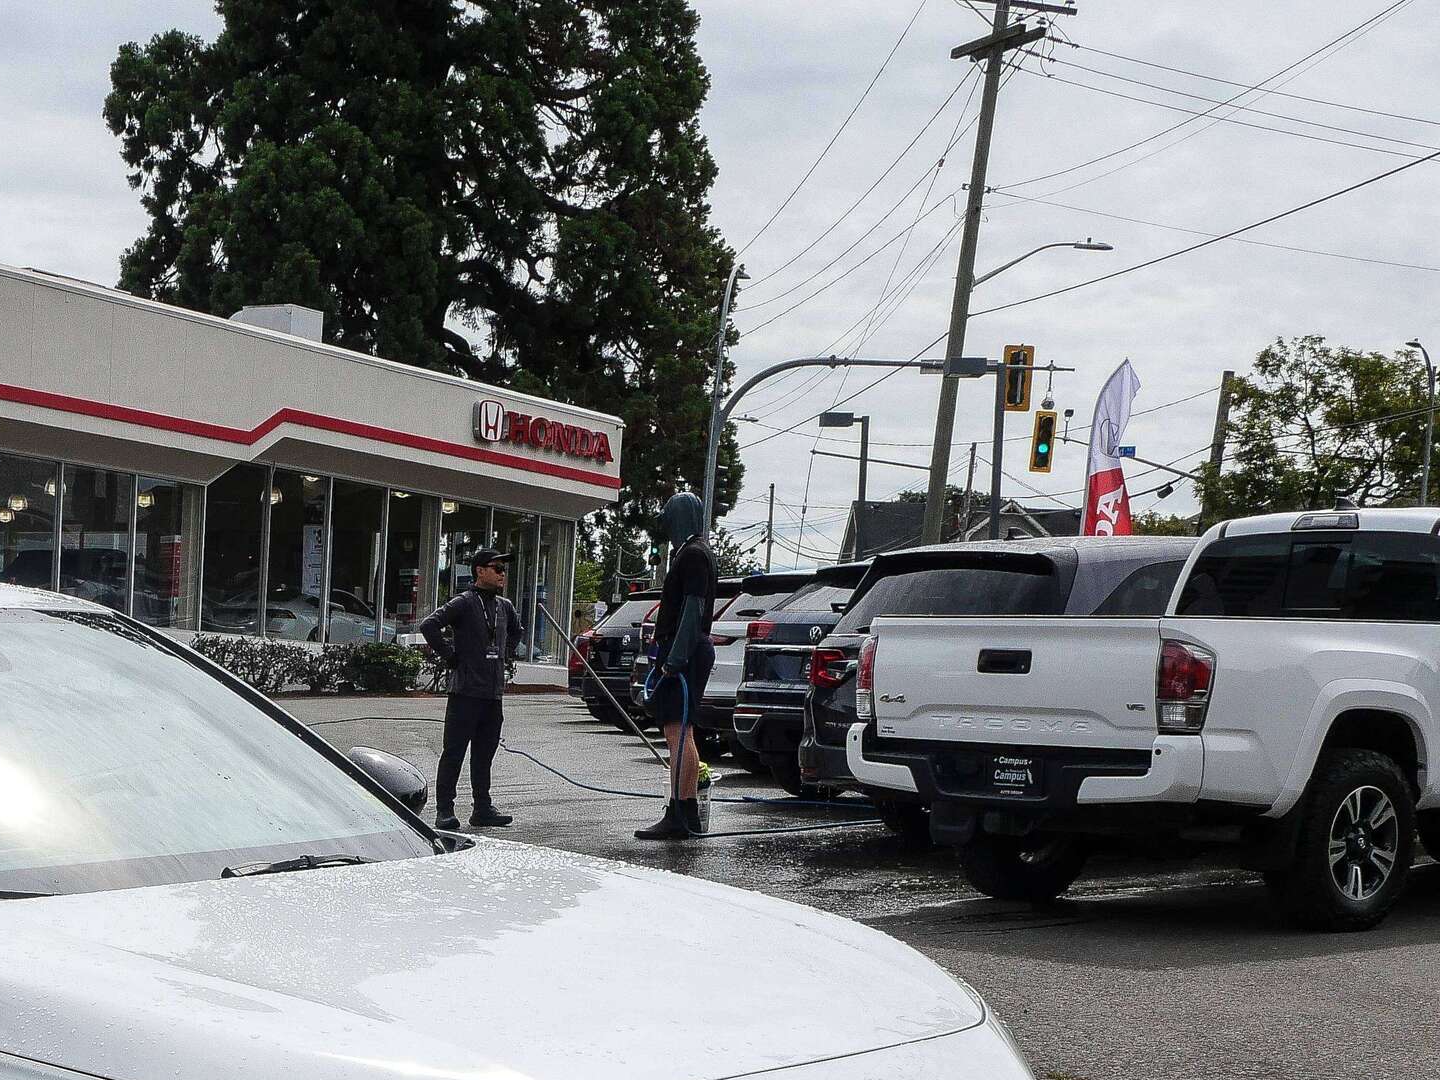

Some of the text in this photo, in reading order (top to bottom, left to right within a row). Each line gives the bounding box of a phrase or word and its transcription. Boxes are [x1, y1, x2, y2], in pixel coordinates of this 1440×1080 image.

[505, 410, 614, 463] HONDA
[998, 755, 1028, 767] Campus
[994, 769, 1026, 783] Campus
